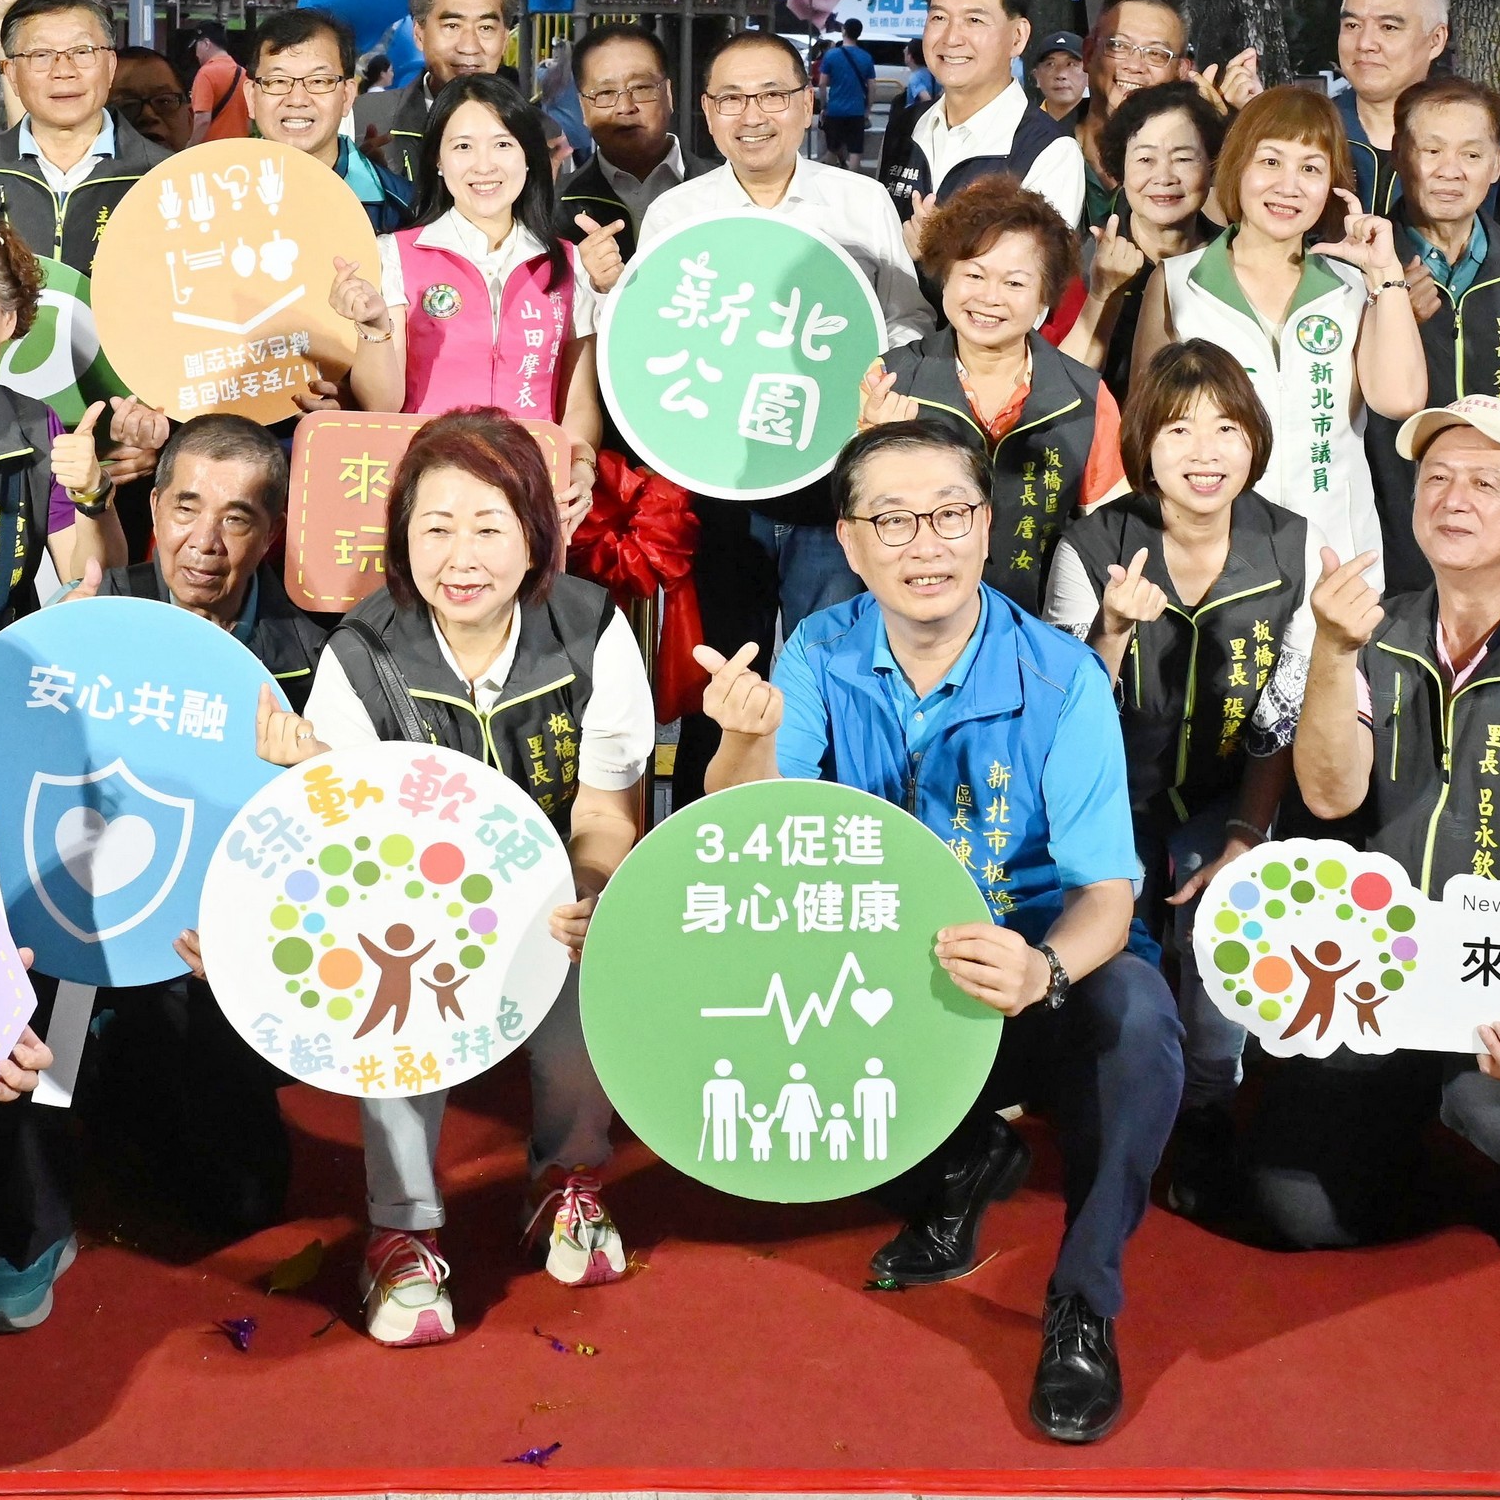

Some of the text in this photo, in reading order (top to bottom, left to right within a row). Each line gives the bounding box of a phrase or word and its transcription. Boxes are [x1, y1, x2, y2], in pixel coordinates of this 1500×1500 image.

[657, 251, 849, 362] 新北
[513, 300, 545, 409] 山田摩衣
[645, 349, 821, 451] 公園
[1308, 361, 1335, 493] 新北市議員
[338, 451, 391, 505] 來
[1019, 461, 1039, 507] 里長
[1043, 447, 1064, 513] 板橋區
[1228, 637, 1250, 687] 里長
[25, 663, 230, 742] 安心共融
[526, 734, 554, 787] 里長
[547, 712, 577, 784] 板橋區
[949, 783, 973, 833] 區長
[1471, 788, 1498, 881] 呂永欽
[695, 816, 885, 867] 3.4促進
[680, 881, 902, 935] 身心健康
